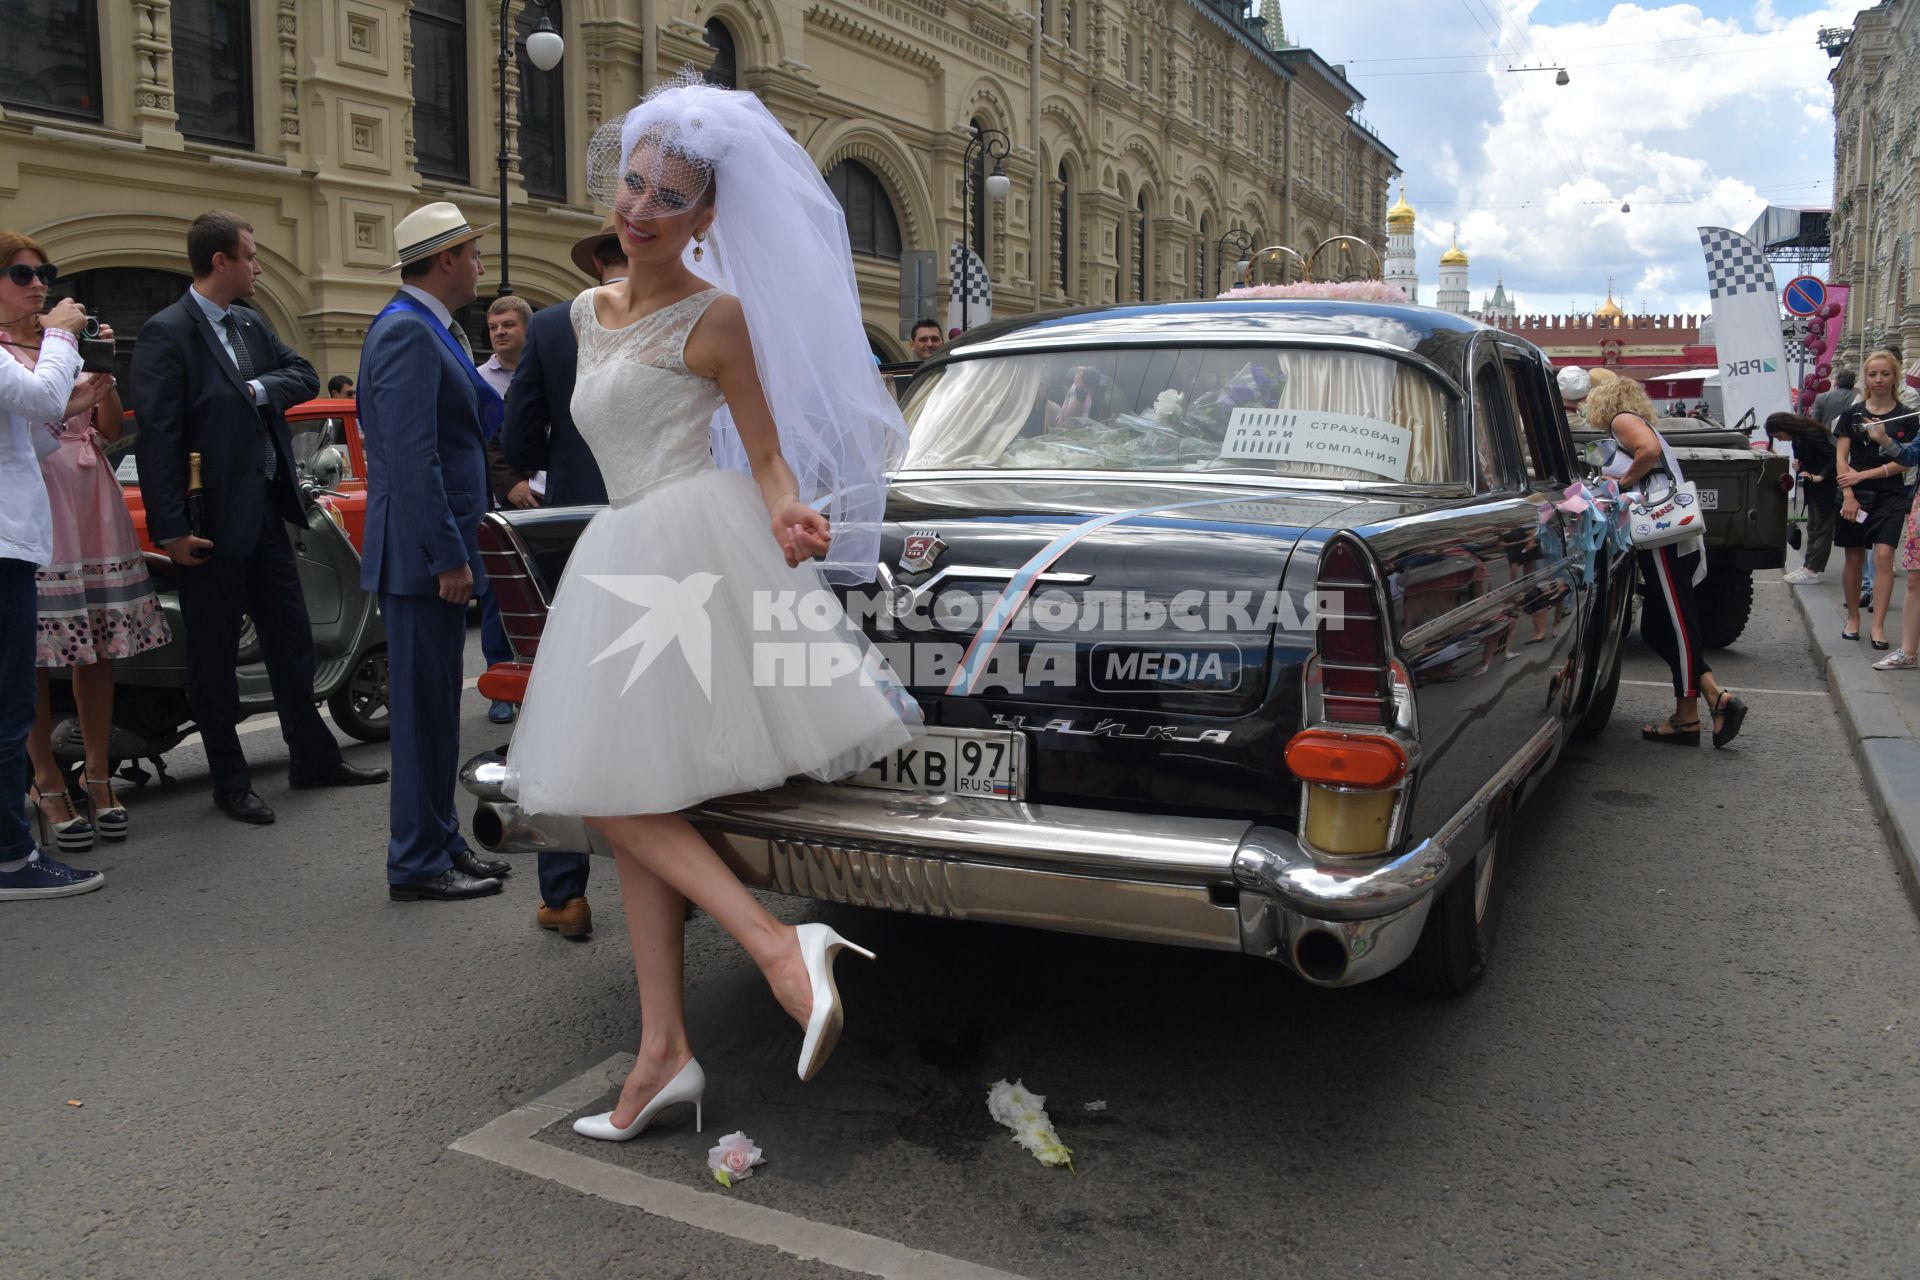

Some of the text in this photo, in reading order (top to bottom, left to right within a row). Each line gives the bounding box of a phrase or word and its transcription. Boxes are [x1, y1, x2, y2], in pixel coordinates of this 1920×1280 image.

[1236, 428, 1293, 439] ПАРИ
[1310, 421, 1400, 446] СТРАХОВАЯ
[1306, 440, 1397, 465] КОМПАНИЯ
[1651, 503, 1675, 521] PARIS
[962, 741, 1005, 778] 97
[961, 778, 992, 792] RUS
